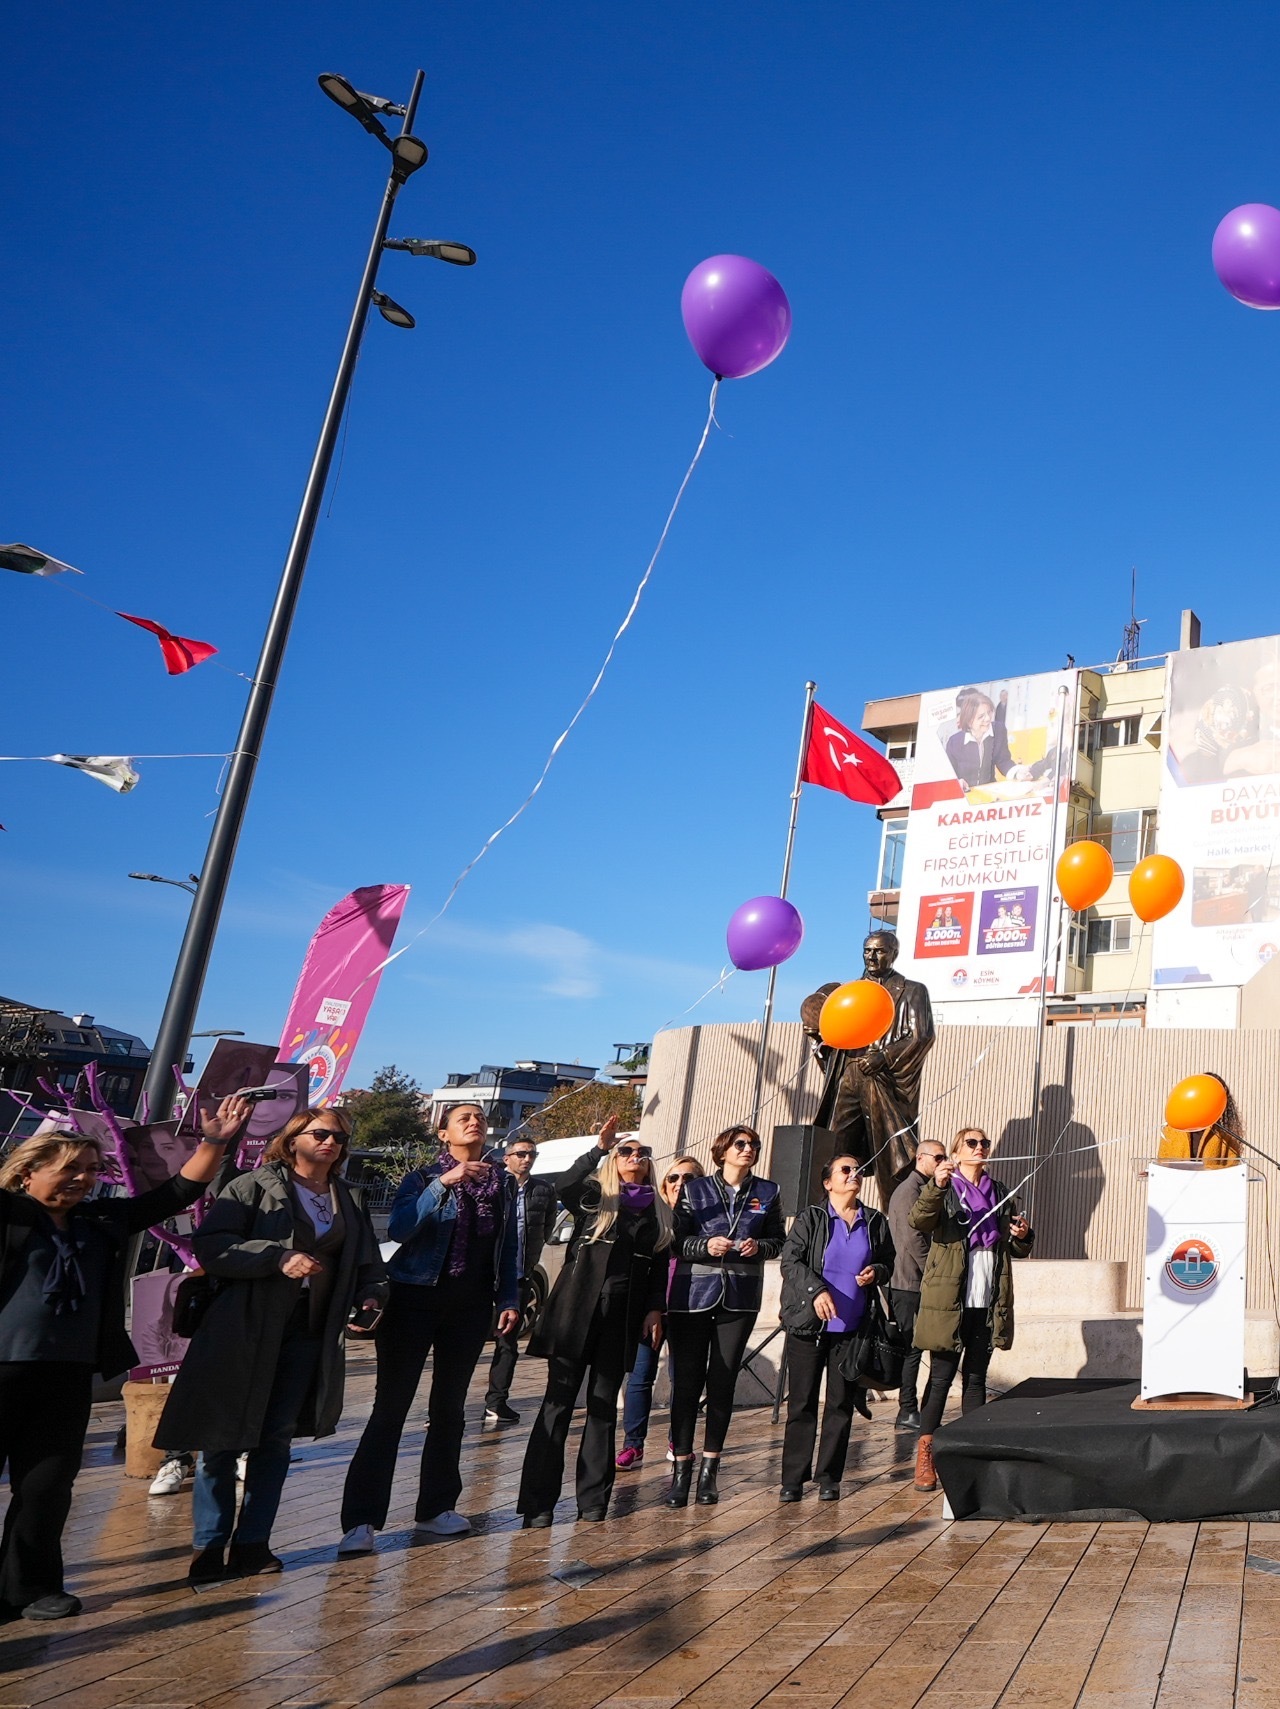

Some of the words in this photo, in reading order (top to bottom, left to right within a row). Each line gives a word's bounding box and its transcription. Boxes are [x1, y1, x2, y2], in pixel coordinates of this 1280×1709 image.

[937, 802, 1042, 827] KARARLIYIZ
[949, 829, 1026, 850] EĞİTİMDE
[1207, 848, 1231, 857] Halk
[1234, 843, 1272, 855] Market
[924, 854, 980, 872] FIRSAT
[983, 843, 1049, 869] EŞİTLİĞİ
[940, 867, 1018, 888] MÜMKÜN
[150, 1363, 182, 1375] HANDA
